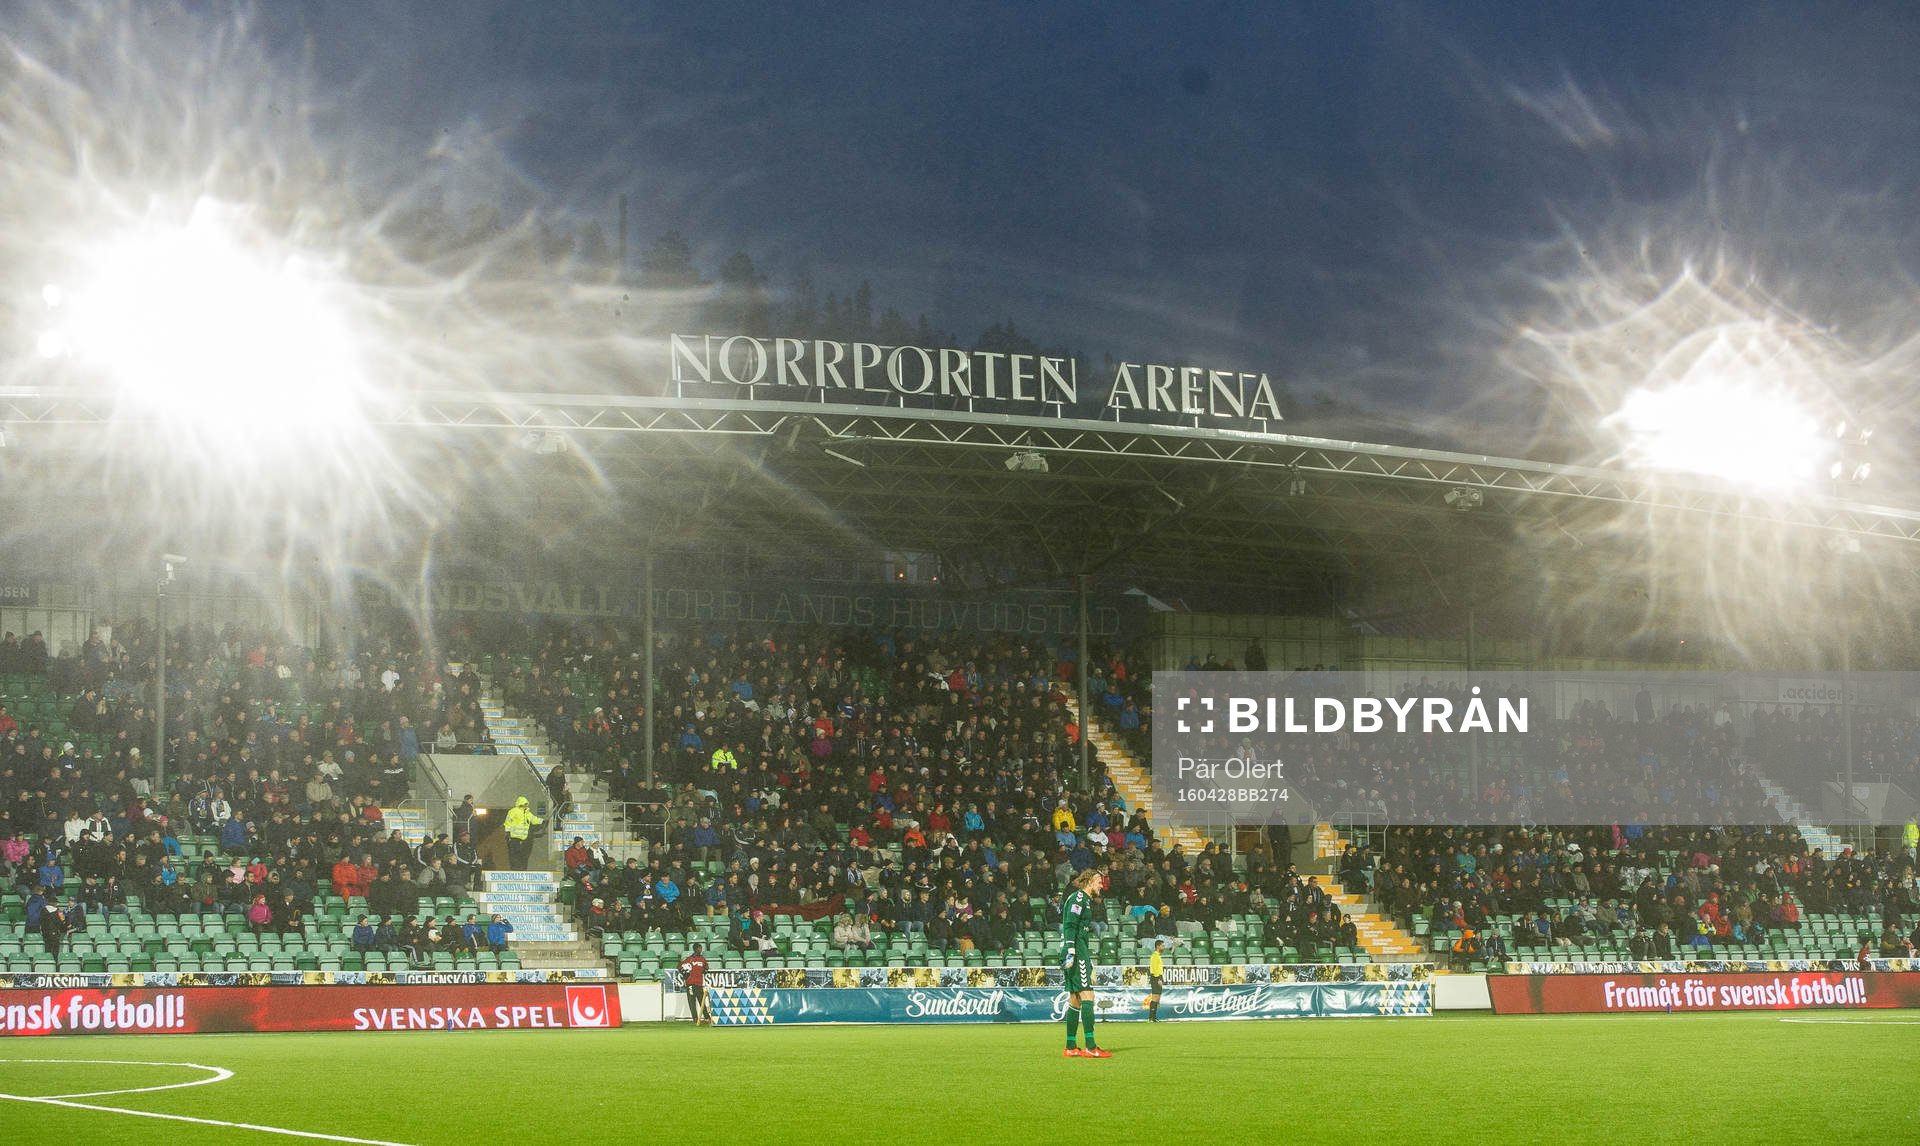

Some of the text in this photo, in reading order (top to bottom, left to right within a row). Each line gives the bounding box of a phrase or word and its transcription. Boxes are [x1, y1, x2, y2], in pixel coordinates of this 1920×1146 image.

[671, 333, 1284, 421] NORRPORTEN ARENA
[888, 597, 1120, 636] HUVUDSTAD
[1162, 968, 1209, 982] NORRLAND
[905, 990, 1004, 1018] Sundsvall
[1174, 986, 1262, 1015] Norrland
[1604, 976, 1868, 1008] Framåt för svensk fotboll!
[67, 994, 185, 1029] fotboll!
[353, 1006, 563, 1030] SVENSKA SPEL
